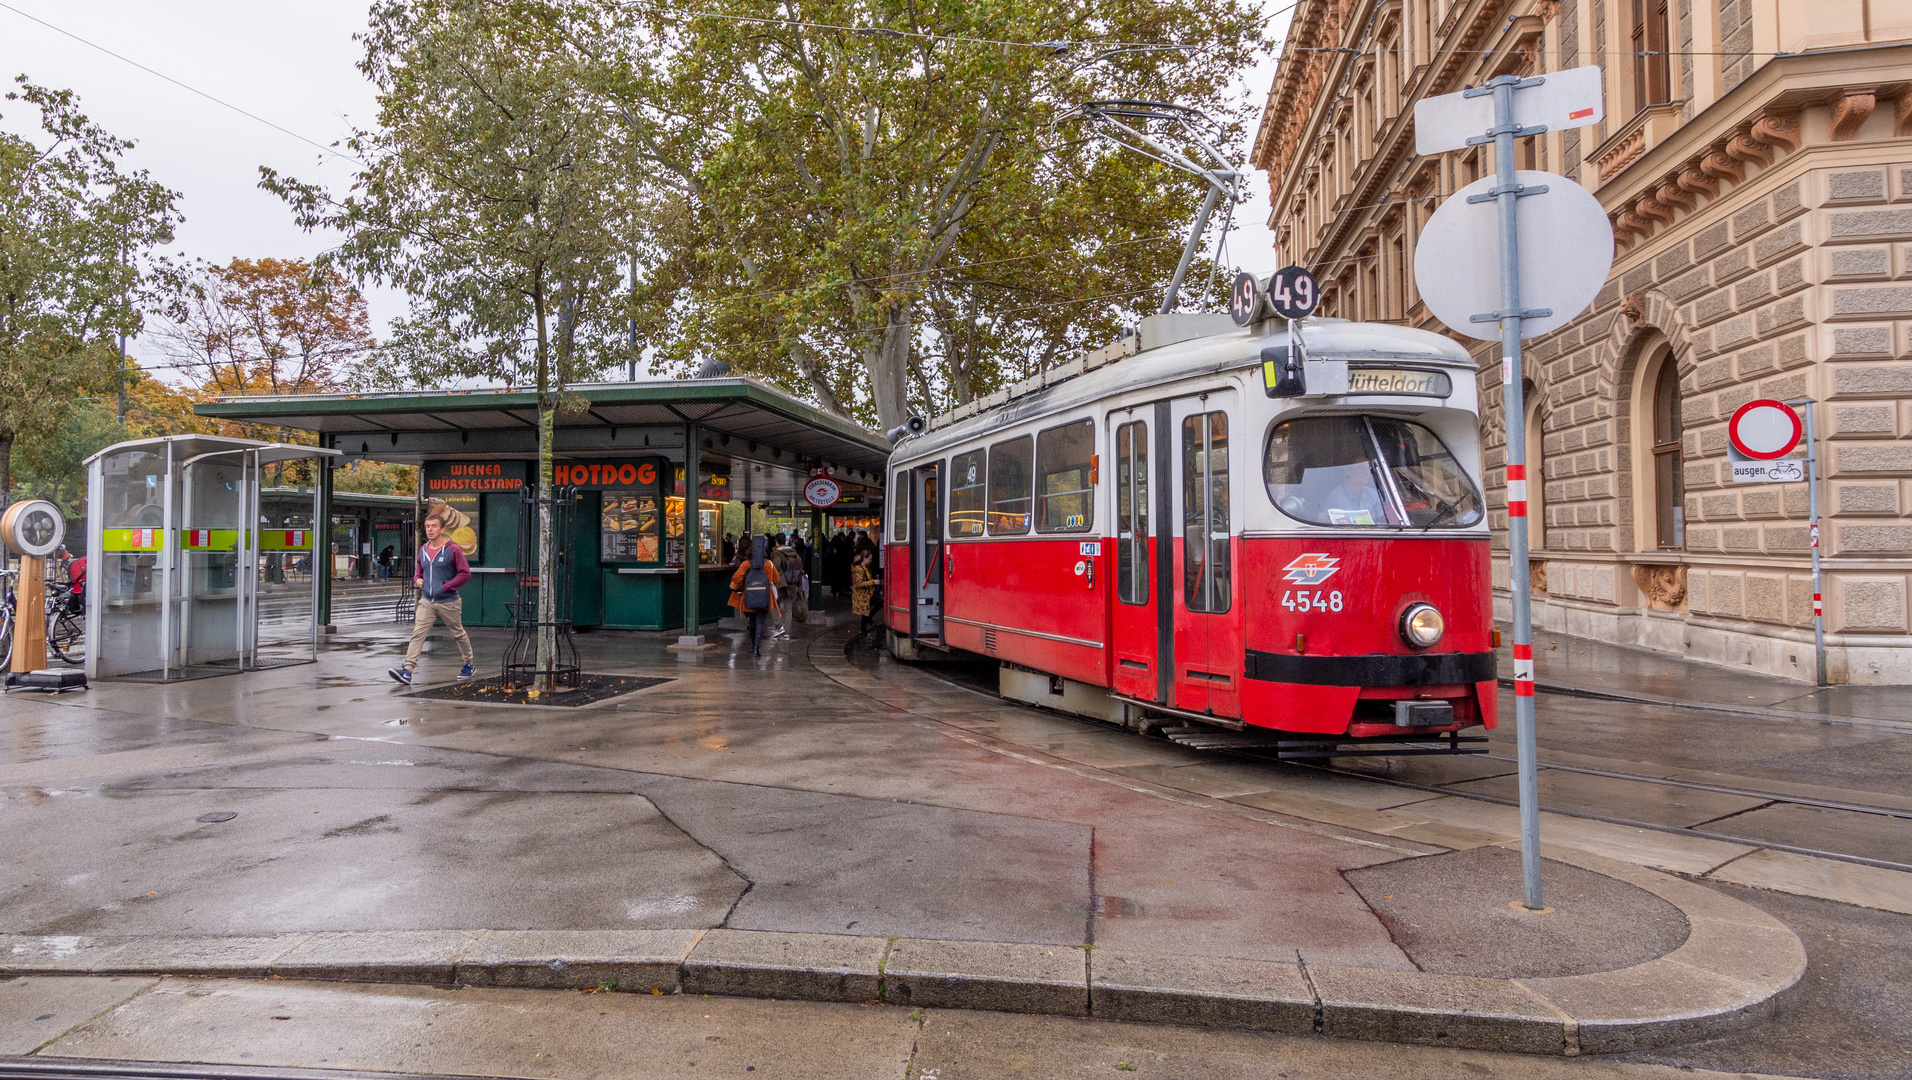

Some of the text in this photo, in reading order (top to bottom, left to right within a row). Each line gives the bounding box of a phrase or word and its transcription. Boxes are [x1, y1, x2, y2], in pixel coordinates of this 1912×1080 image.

[1233, 278, 1255, 318] 49
[1273, 274, 1314, 311] 49
[450, 464, 502, 476] WIENER
[555, 463, 657, 486] HOTDOG
[967, 465, 977, 483] 49
[1734, 467, 1768, 478] ausgen.
[429, 476, 524, 490] WÜRSTELSTAND
[1281, 590, 1344, 613] 4548
